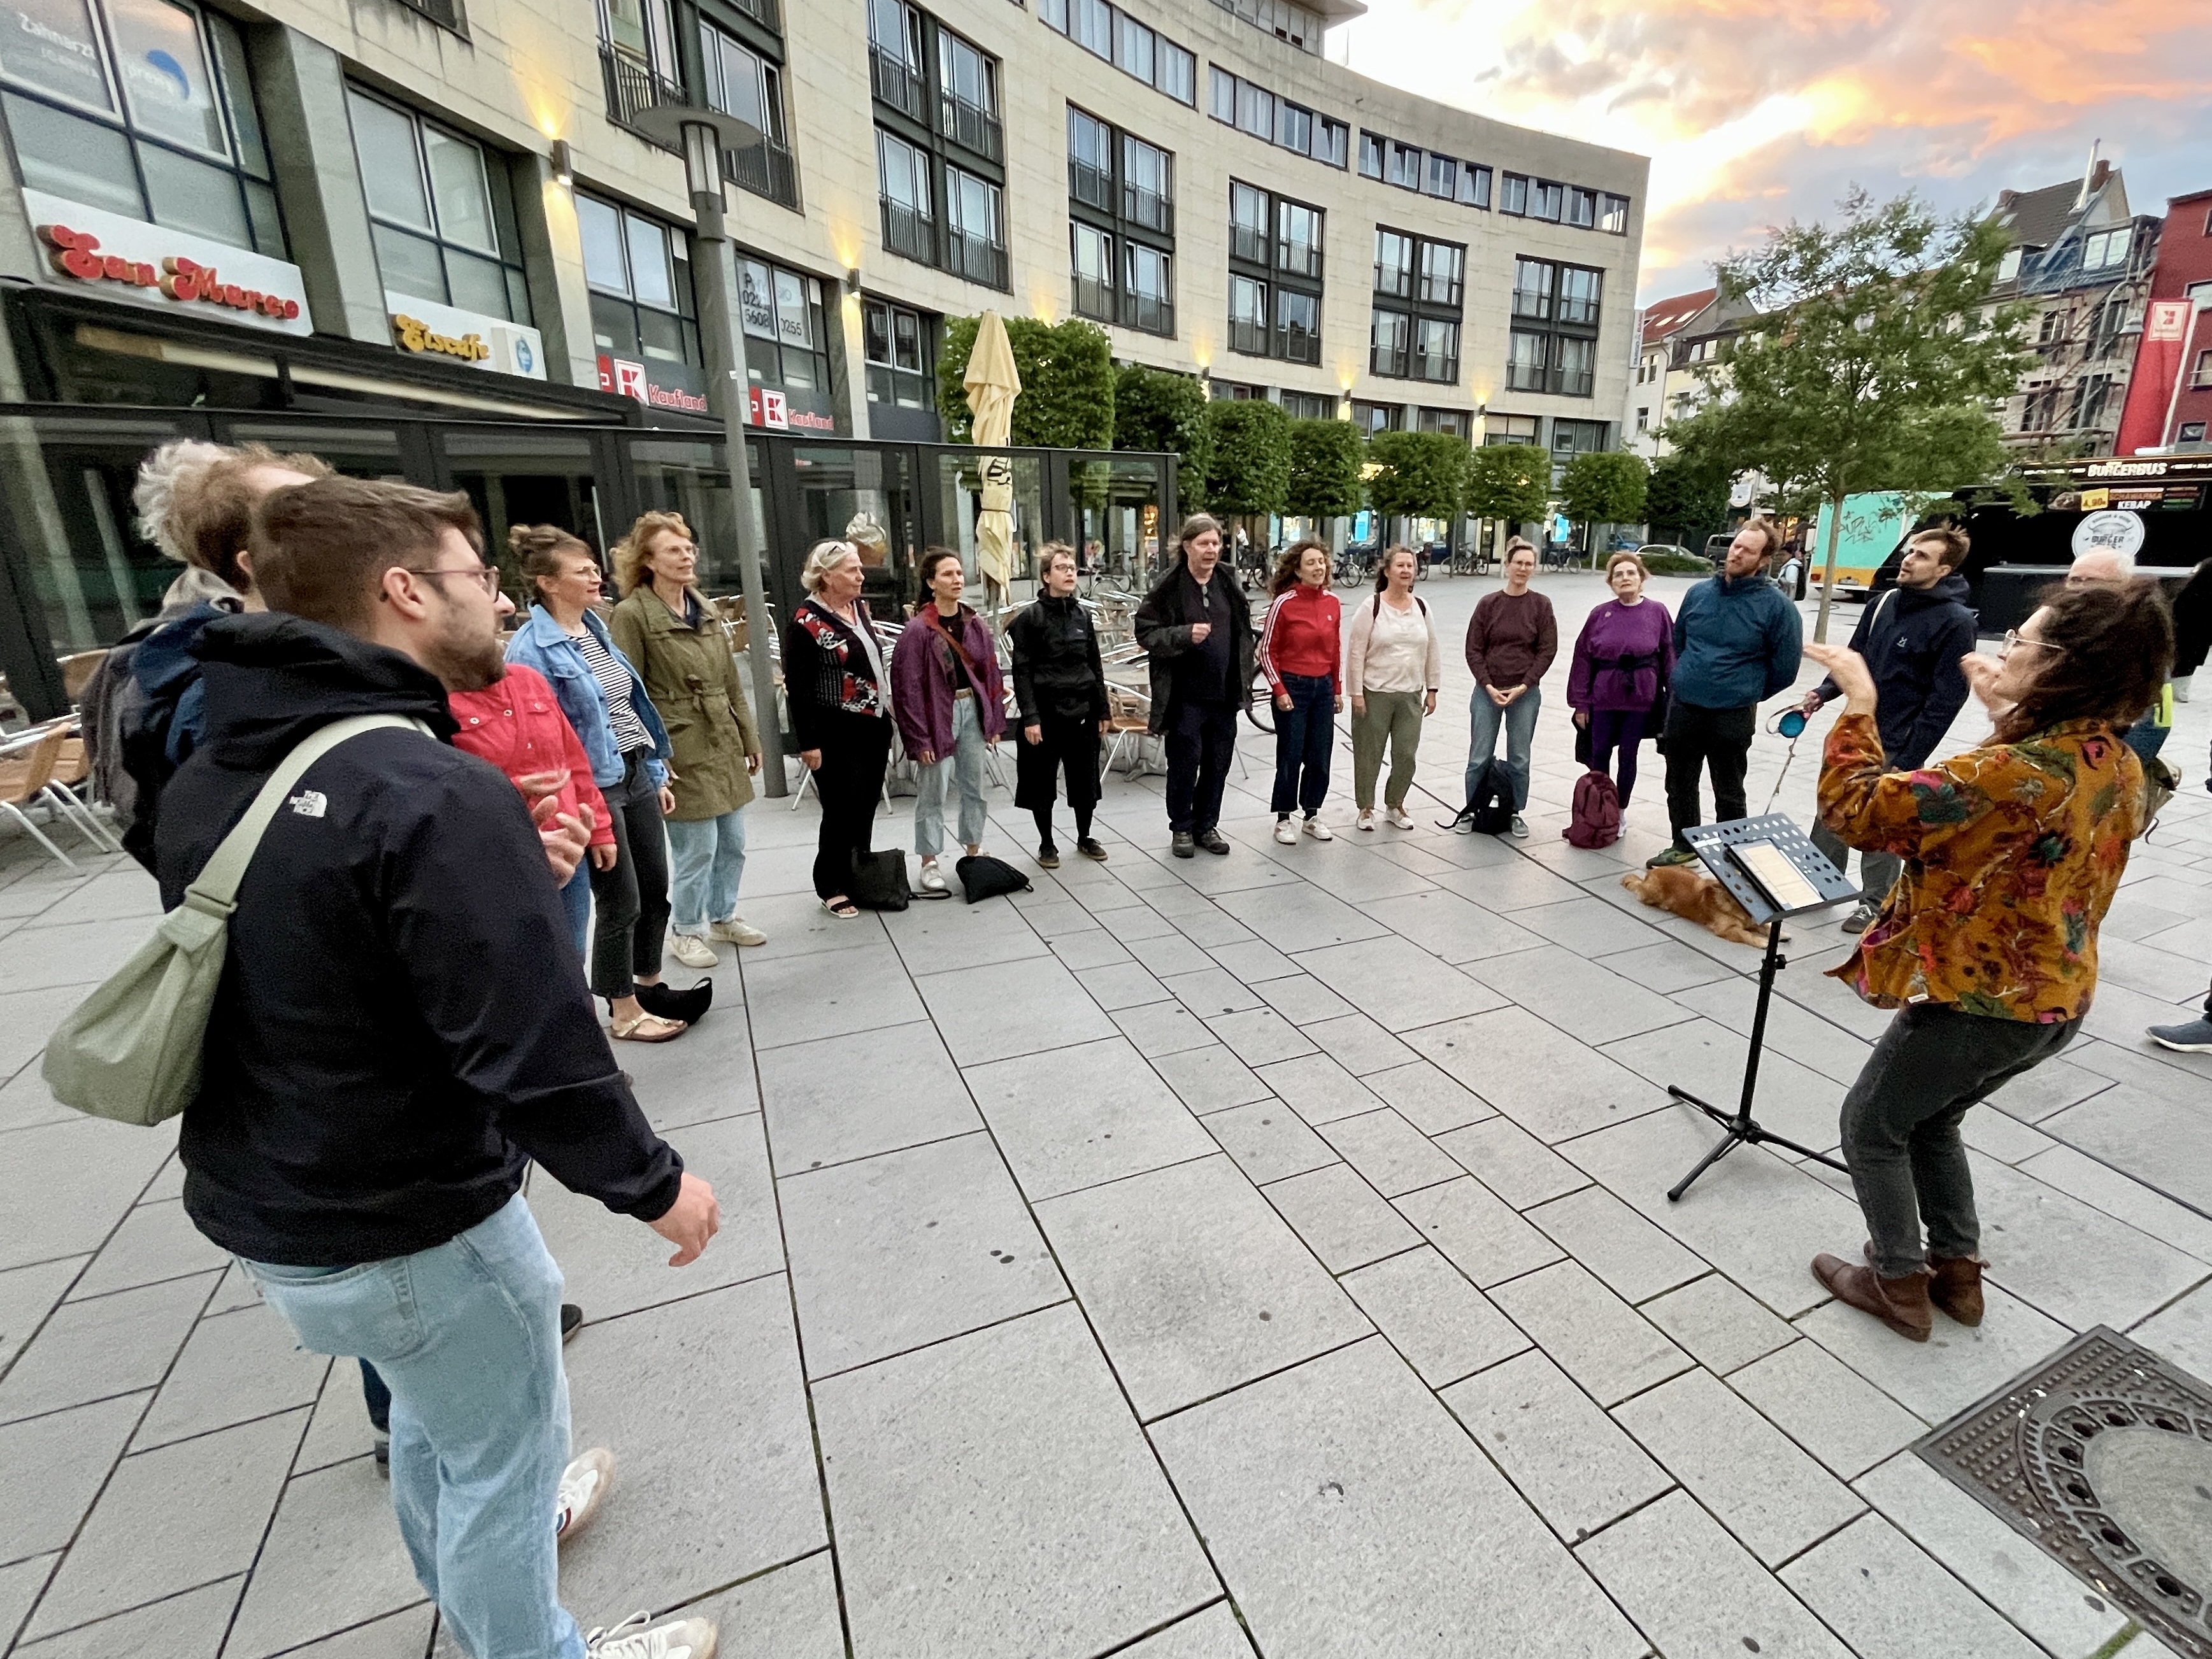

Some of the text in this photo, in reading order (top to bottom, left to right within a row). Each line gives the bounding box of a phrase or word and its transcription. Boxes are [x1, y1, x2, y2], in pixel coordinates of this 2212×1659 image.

[648, 383, 708, 412] Kaufland
[787, 408, 834, 431] Kaufland
[2117, 500, 2152, 509] KEBAP
